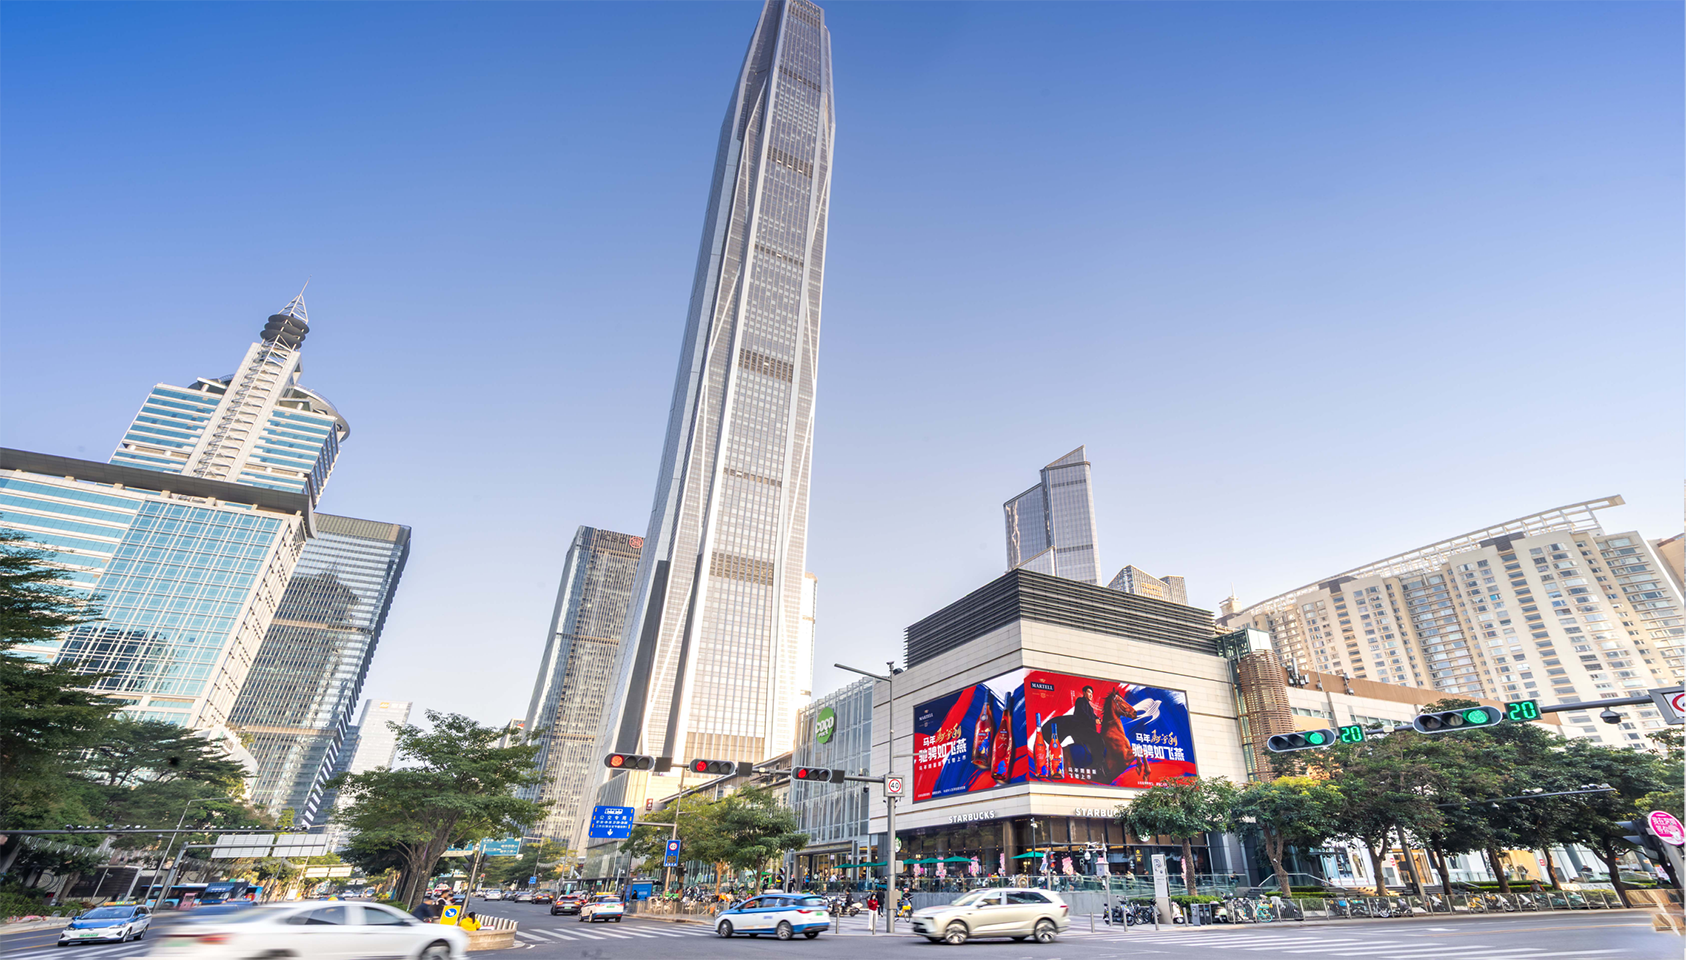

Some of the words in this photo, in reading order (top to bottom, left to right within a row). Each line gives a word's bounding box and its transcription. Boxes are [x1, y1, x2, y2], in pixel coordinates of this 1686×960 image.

[1031, 683, 1054, 691] MARTELL
[1509, 701, 1537, 720] 20
[1341, 725, 1363, 743] 20
[1131, 743, 1186, 762] 驰骋如飞燕
[948, 810, 996, 824] STARBUCKS
[1075, 807, 1123, 818] STARBUC
